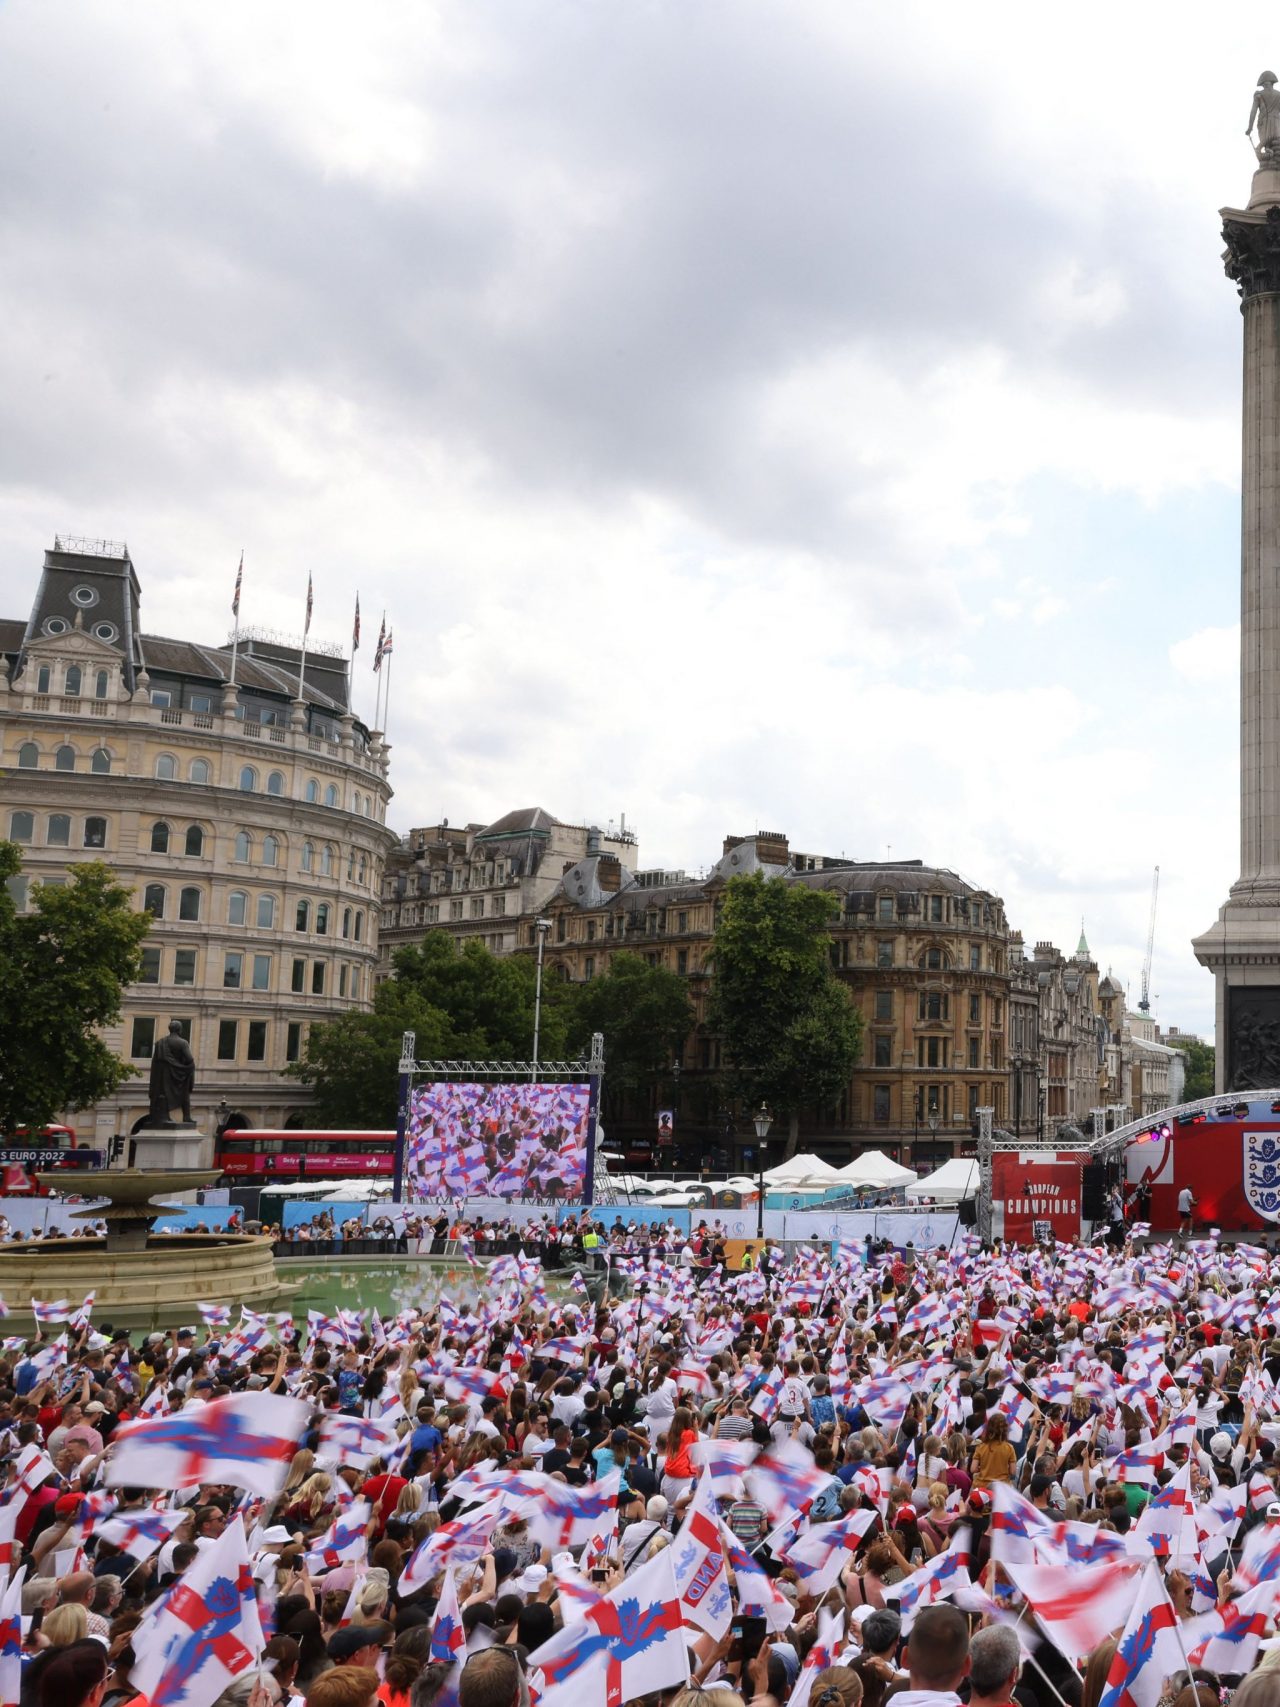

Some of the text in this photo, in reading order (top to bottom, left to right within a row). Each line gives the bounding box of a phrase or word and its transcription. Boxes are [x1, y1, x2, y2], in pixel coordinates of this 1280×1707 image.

[9, 1151, 37, 1161] EURO
[39, 1151, 65, 1161] 2022
[1025, 1183, 1060, 1196] UROPEAN
[1007, 1199, 1077, 1214] CHAMPIONS
